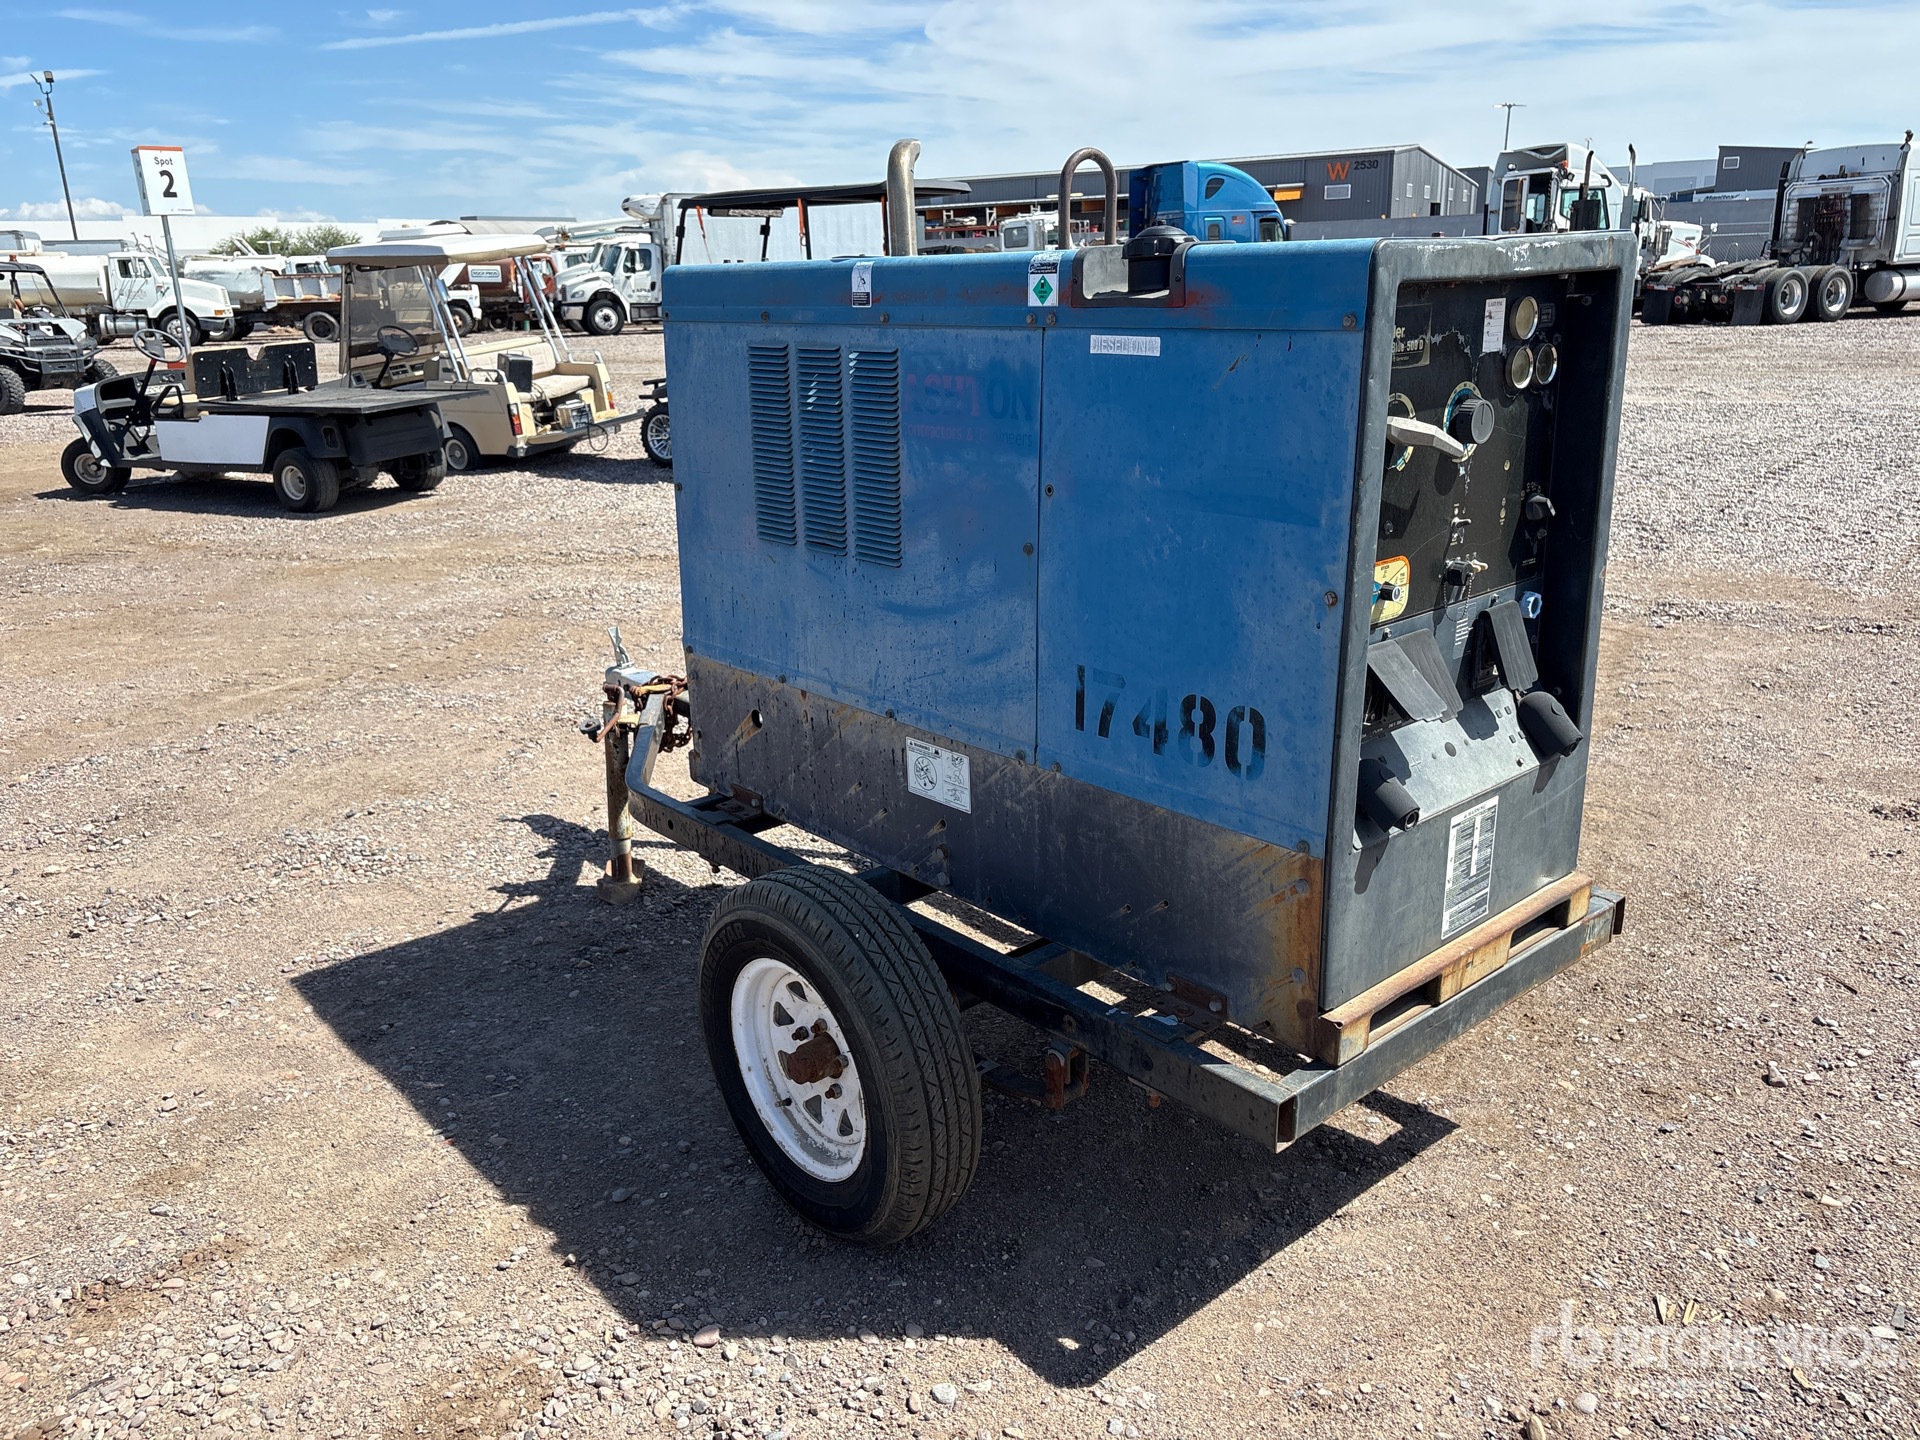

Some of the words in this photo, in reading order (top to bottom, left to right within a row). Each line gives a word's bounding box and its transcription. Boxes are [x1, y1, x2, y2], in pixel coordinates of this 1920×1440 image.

[154, 156, 173, 167] Spot
[1354, 159, 1379, 171] 2530
[1327, 161, 1350, 182] W
[159, 169, 178, 198] 2
[1406, 340, 1418, 351] 500
[1419, 339, 1424, 350] D
[1075, 664, 1267, 781] 17480
